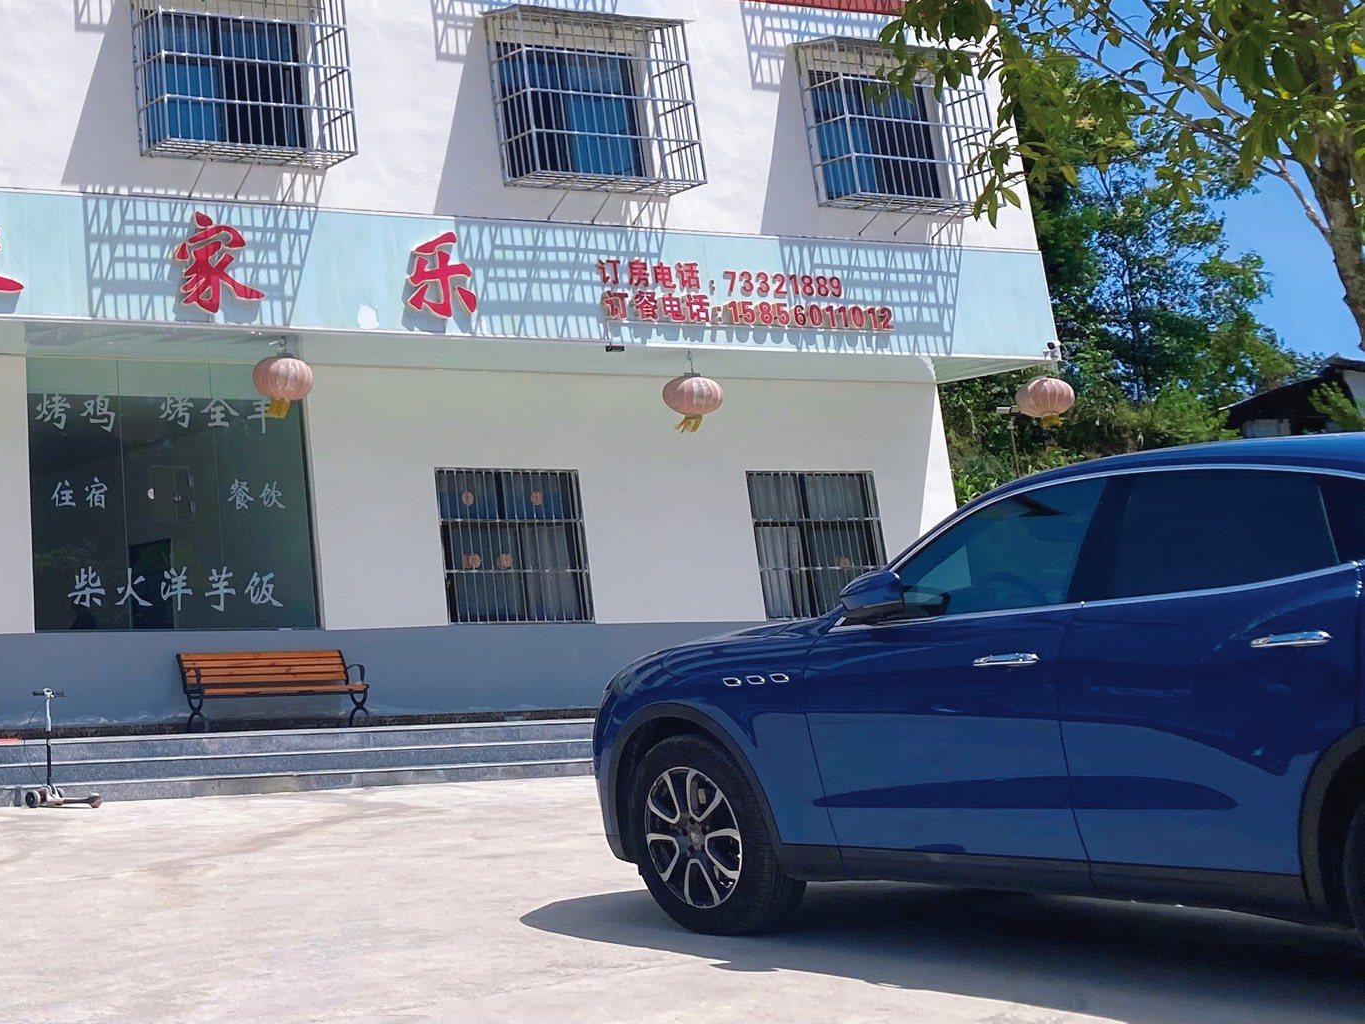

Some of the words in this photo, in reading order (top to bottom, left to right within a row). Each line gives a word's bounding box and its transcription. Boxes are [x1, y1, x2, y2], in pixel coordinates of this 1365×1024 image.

[50, 476, 109, 510] 住宿
[226, 478, 287, 511] 餐饮
[67, 565, 285, 612] 柴火洋芋饭
